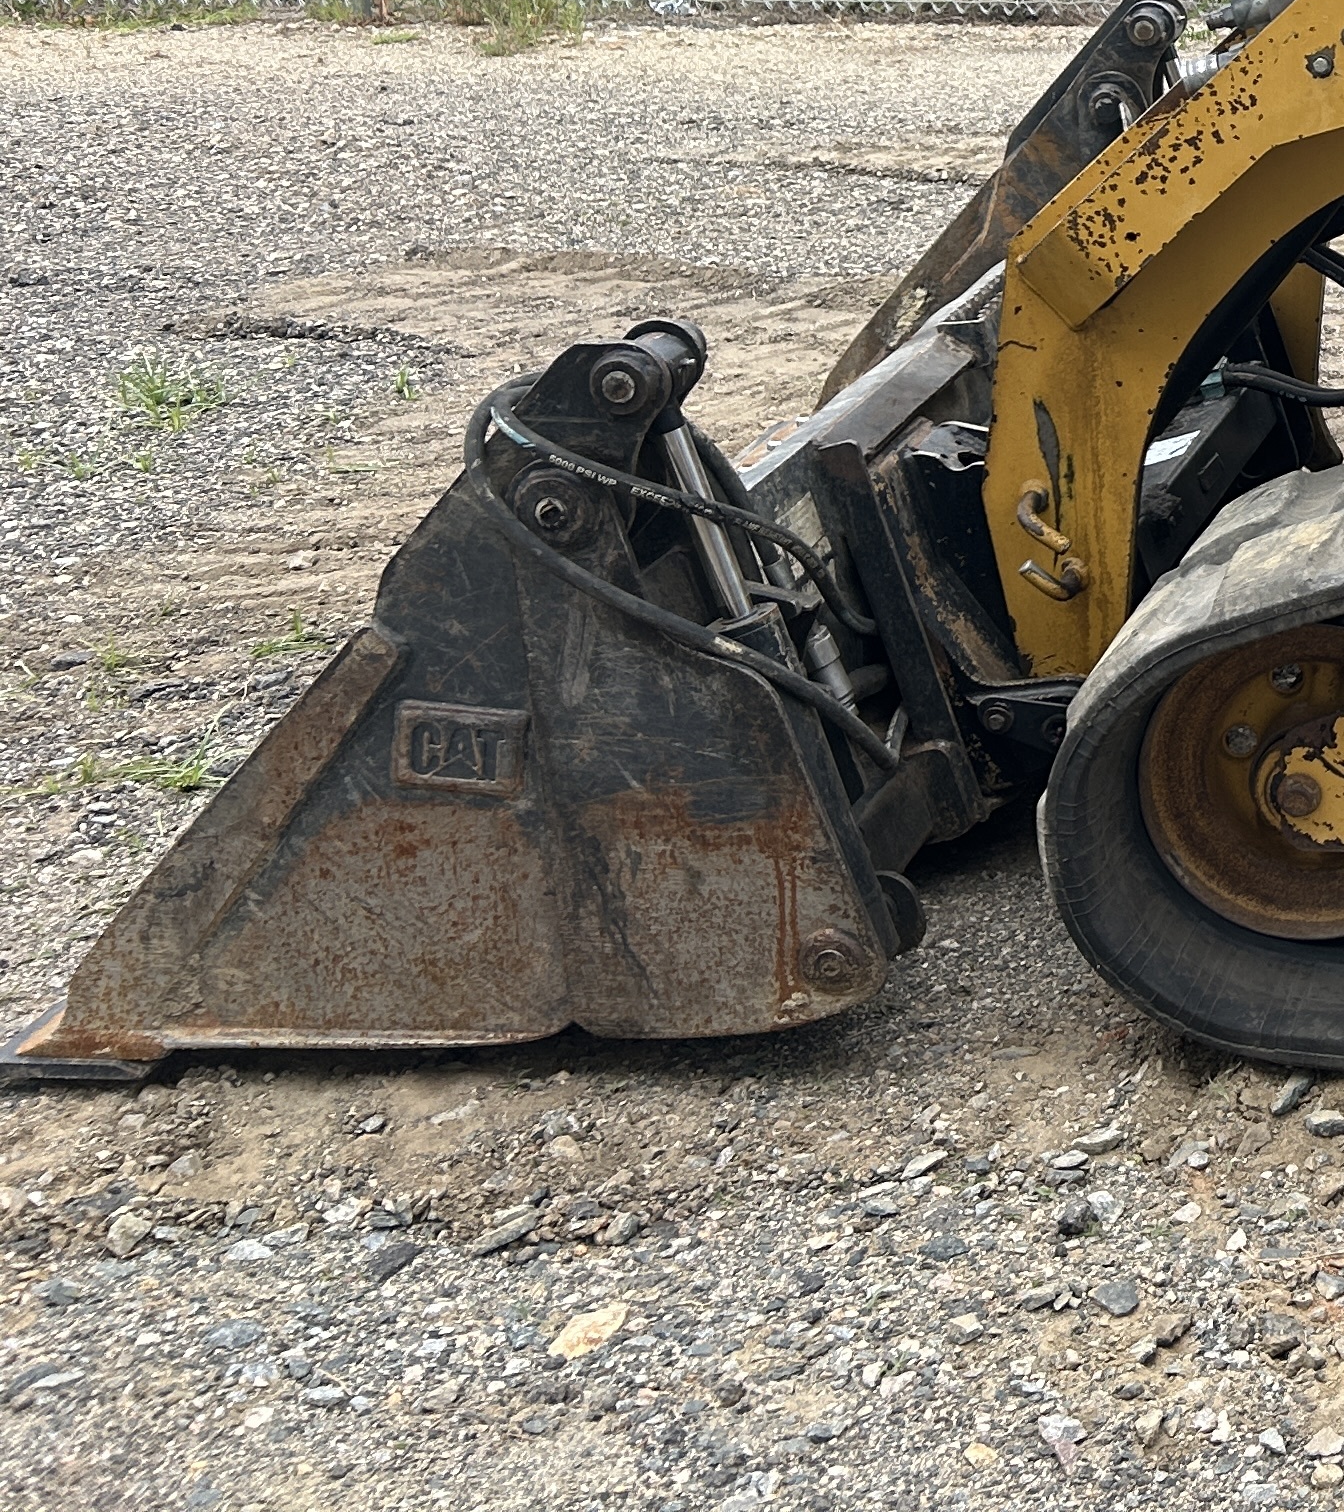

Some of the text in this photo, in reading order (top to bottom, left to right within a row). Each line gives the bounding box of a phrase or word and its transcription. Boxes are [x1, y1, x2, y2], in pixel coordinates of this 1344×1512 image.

[575, 465, 596, 480] PSI
[597, 474, 617, 486] WP
[411, 720, 507, 781] CAT
